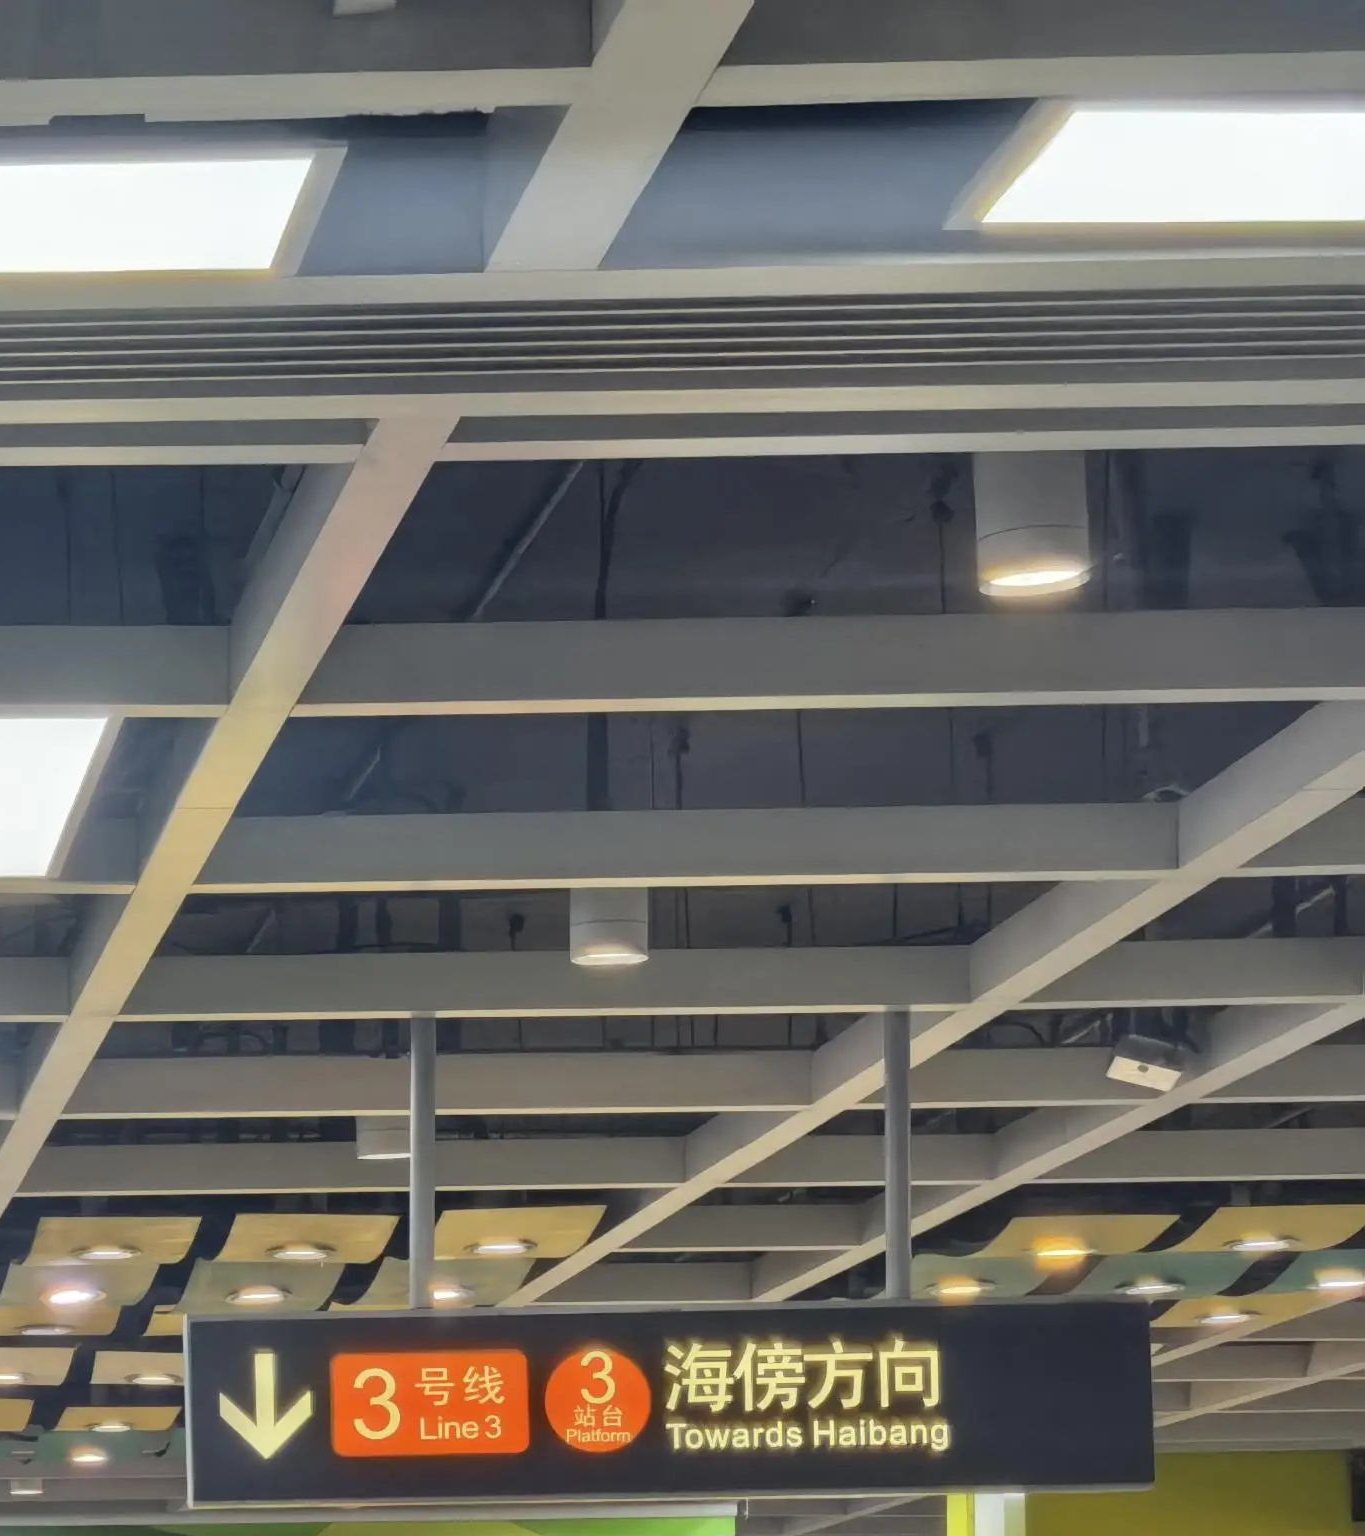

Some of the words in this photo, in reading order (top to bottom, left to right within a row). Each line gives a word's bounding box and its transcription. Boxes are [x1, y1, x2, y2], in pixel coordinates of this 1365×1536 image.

[579, 1350, 616, 1405] 3
[665, 1340, 940, 1411] 海傍方向
[352, 1366, 506, 1440] 3号线
[572, 1404, 624, 1428] 站台
[419, 1415, 479, 1440] Line
[565, 1427, 631, 1445] Platform
[666, 1422, 804, 1449] Towards
[813, 1419, 951, 1453] Haibang
